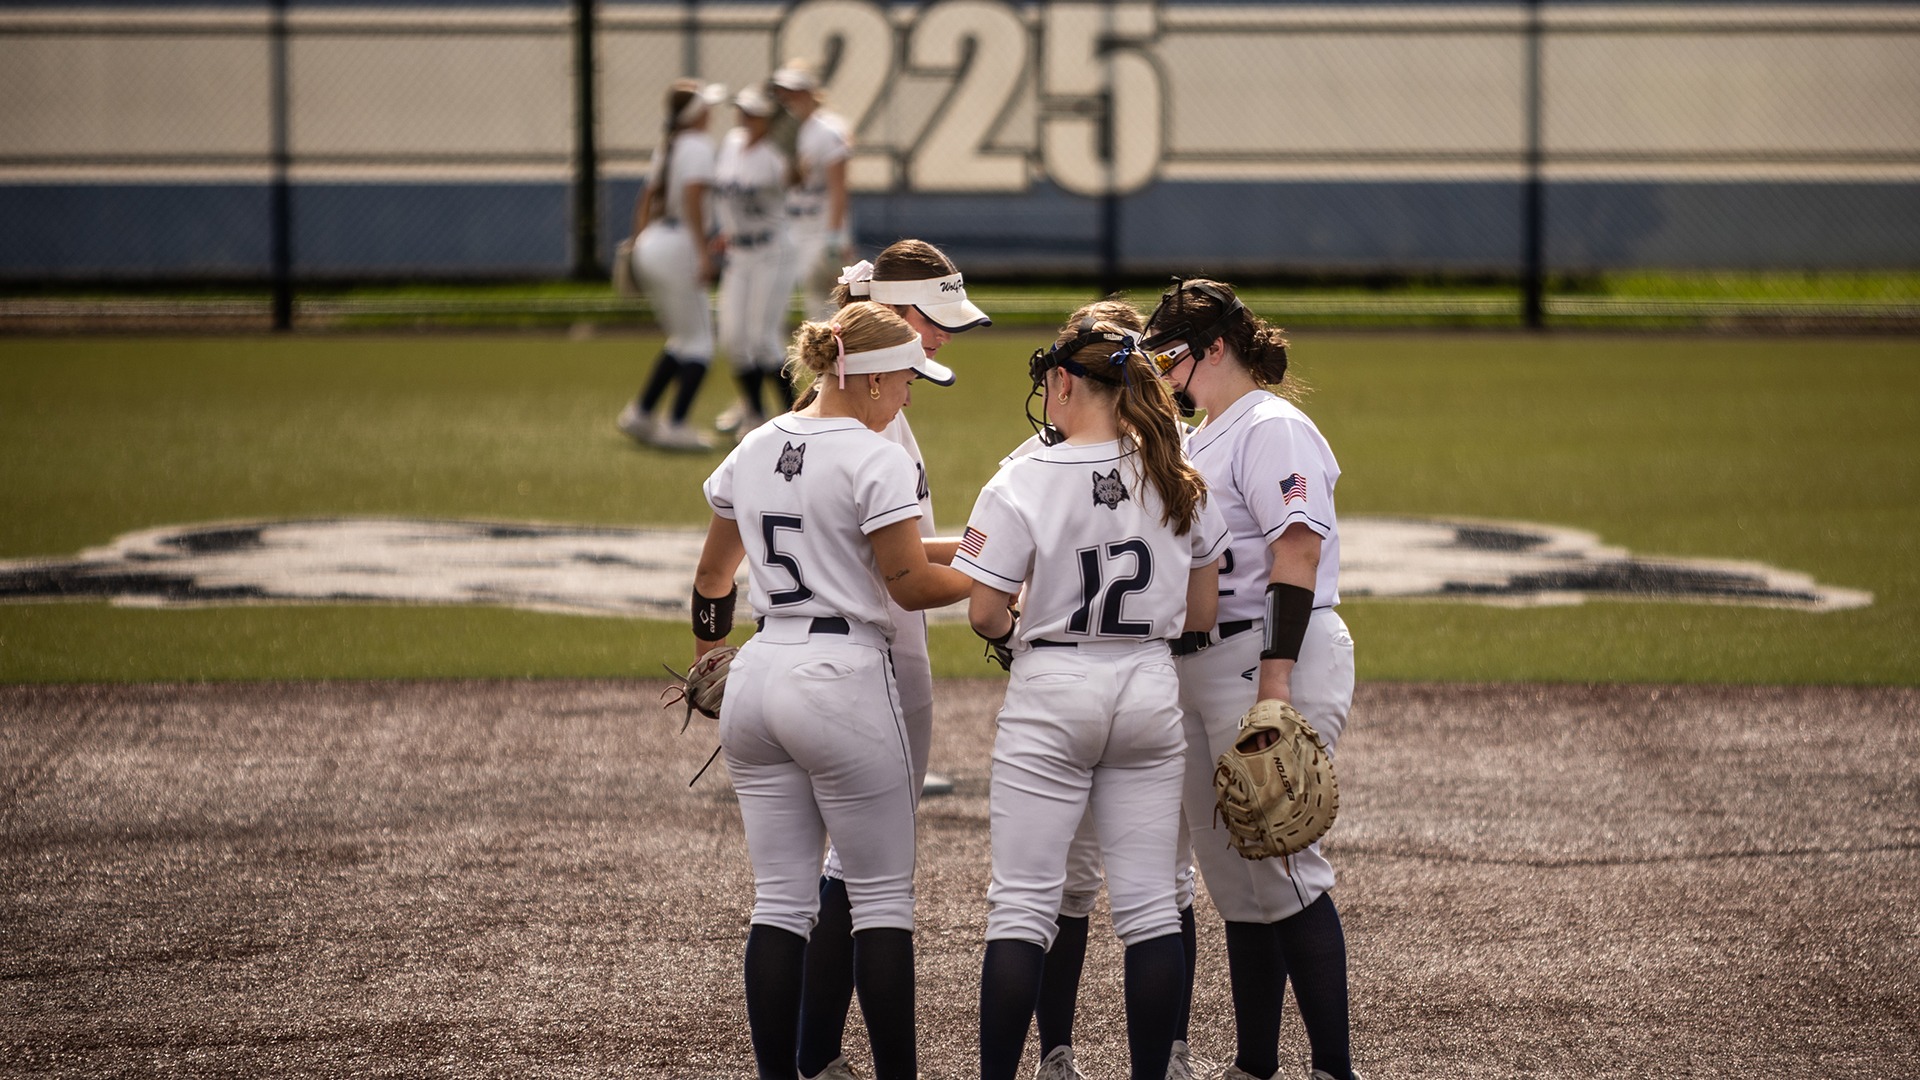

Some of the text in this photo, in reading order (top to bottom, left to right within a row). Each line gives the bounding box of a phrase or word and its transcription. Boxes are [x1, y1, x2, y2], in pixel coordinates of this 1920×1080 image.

[777, 0, 1167, 196] 225
[760, 511, 815, 609] 5
[1065, 536, 1155, 638] 12
[1273, 756, 1295, 801] EASTON
